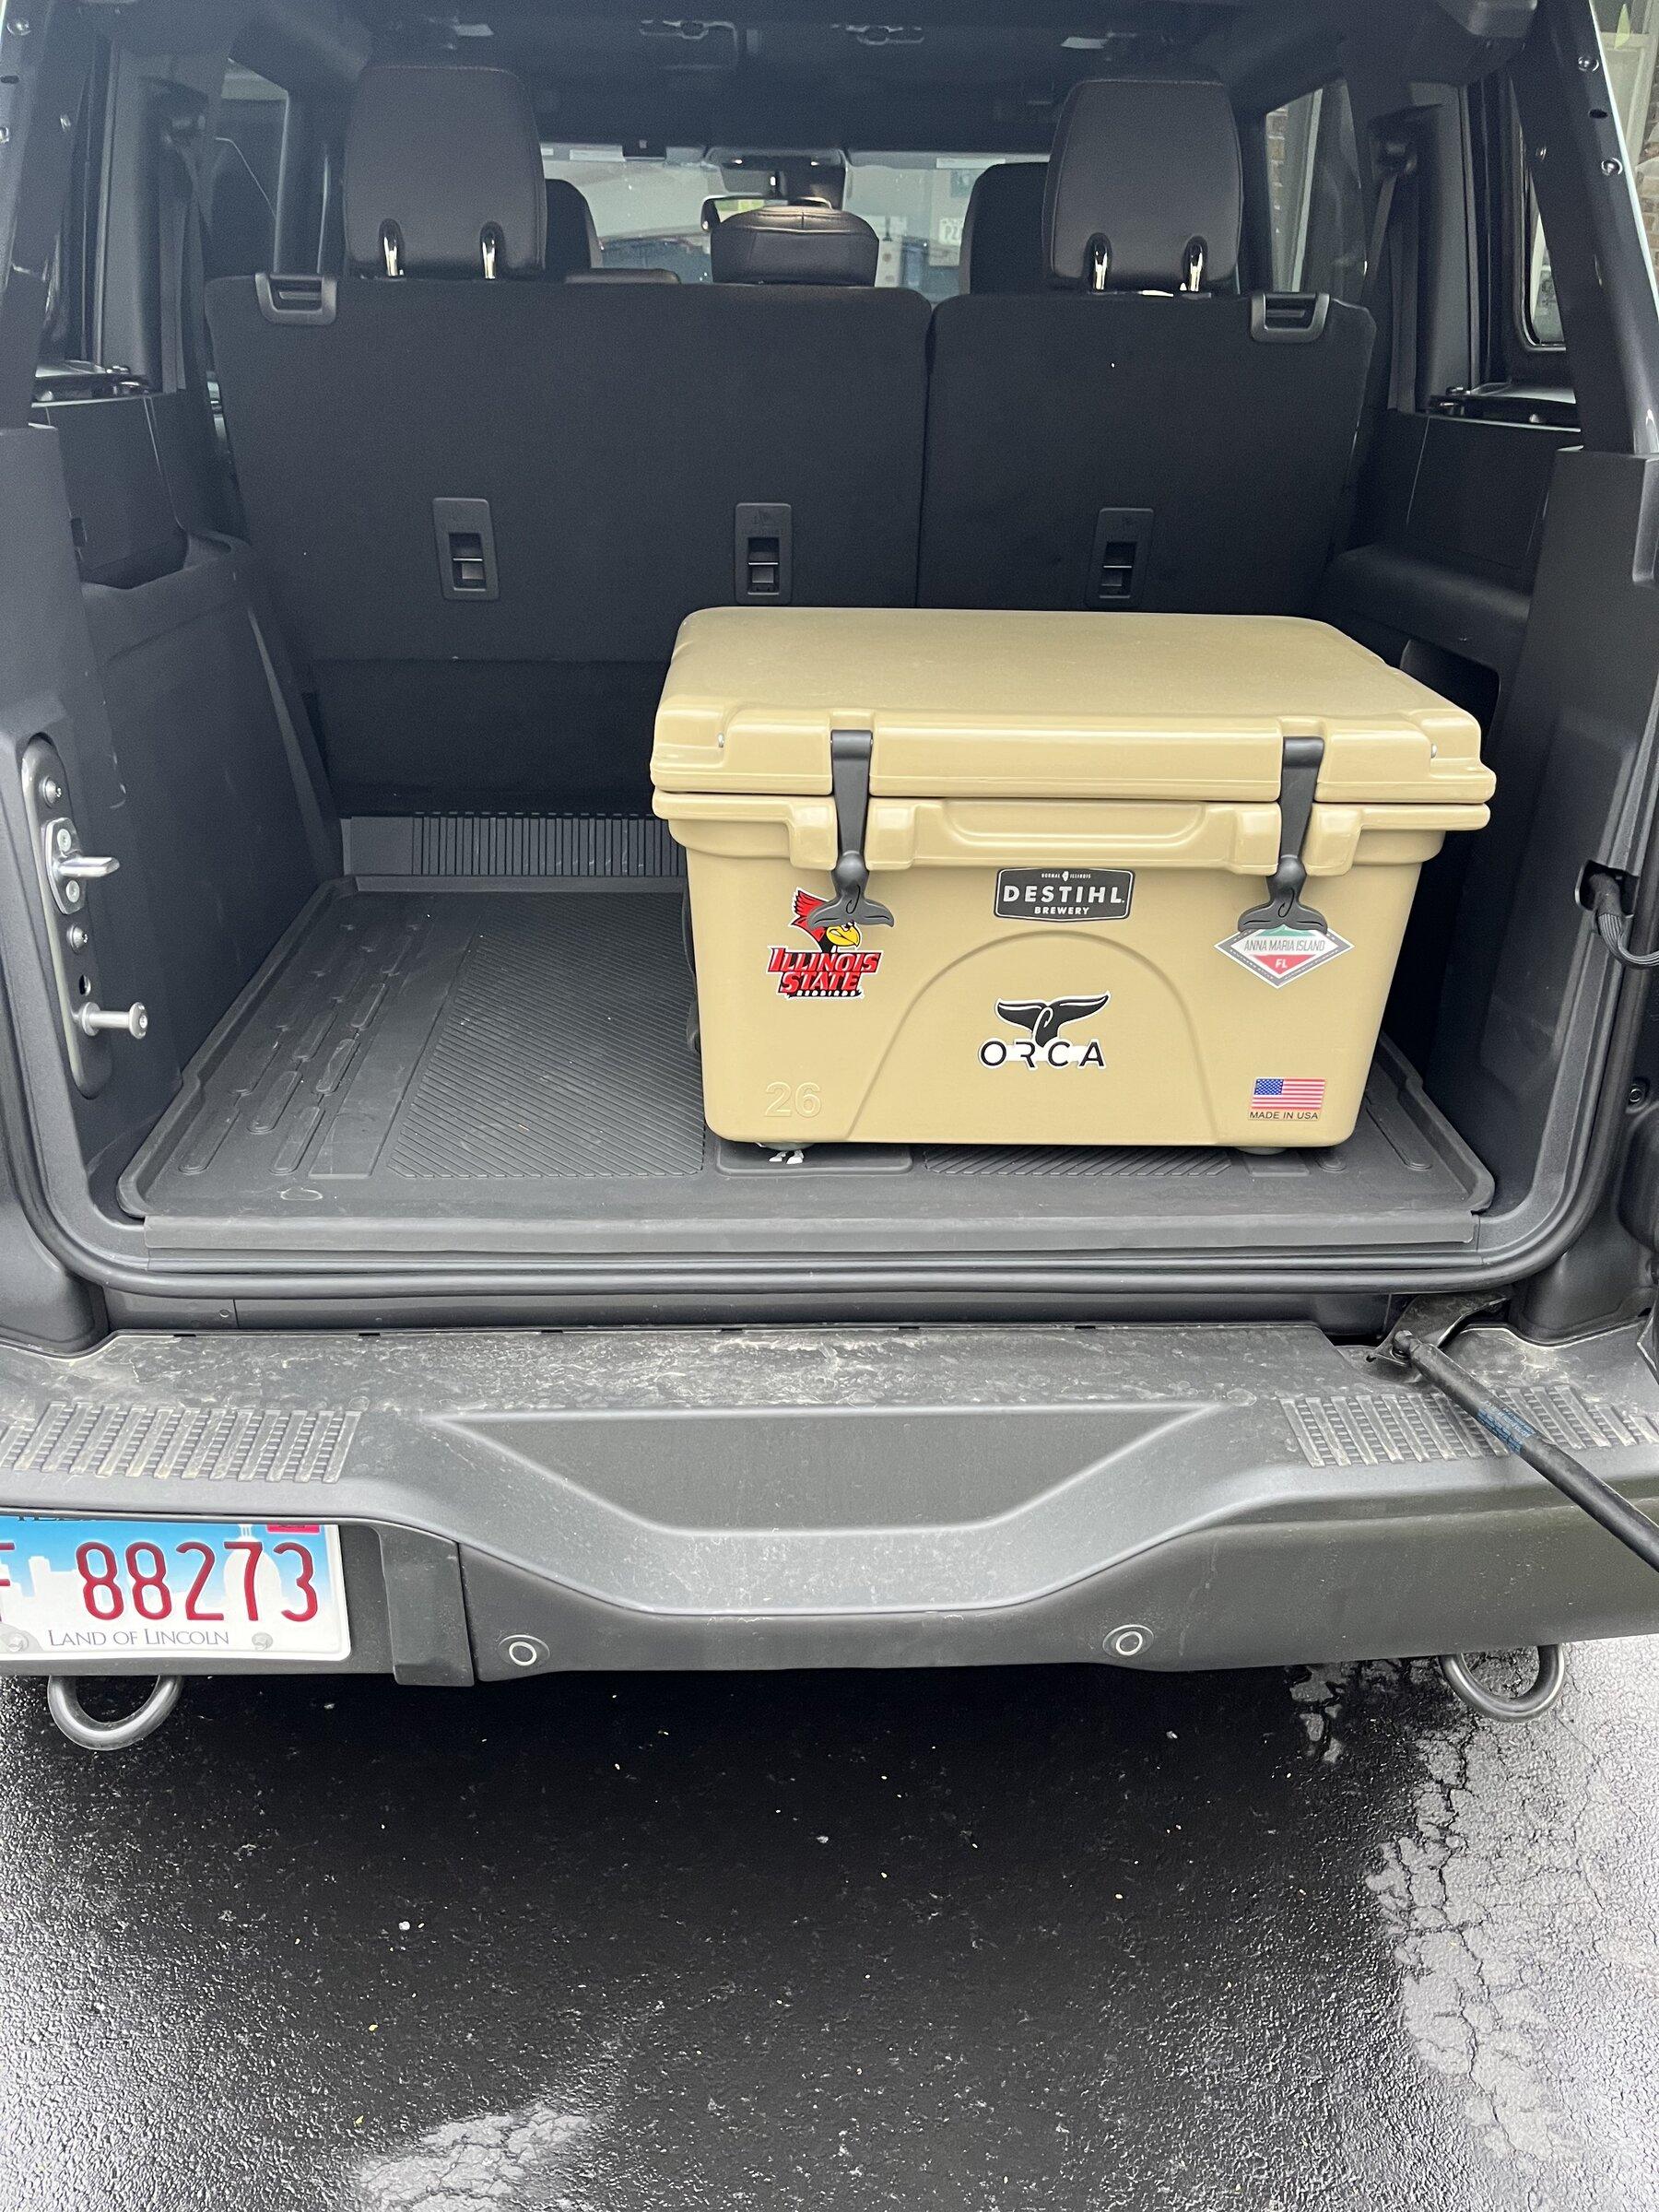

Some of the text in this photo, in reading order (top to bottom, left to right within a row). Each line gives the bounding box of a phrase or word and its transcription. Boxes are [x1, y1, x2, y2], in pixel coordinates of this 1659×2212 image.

[1034, 906, 1090, 915] BREWERY
[1244, 939, 1325, 951] ANNA MARIA ISLAND
[768, 947, 881, 972] ILLINOIS
[1275, 959, 1288, 969] FL
[779, 971, 862, 994] STATE
[980, 1041, 1105, 1068] ORCA
[764, 1081, 822, 1118] 26
[1249, 1112, 1319, 1120] MADE IN USA
[76, 1541, 319, 1622] 88273
[48, 1628, 229, 1647] LAND OF LINCOLN
